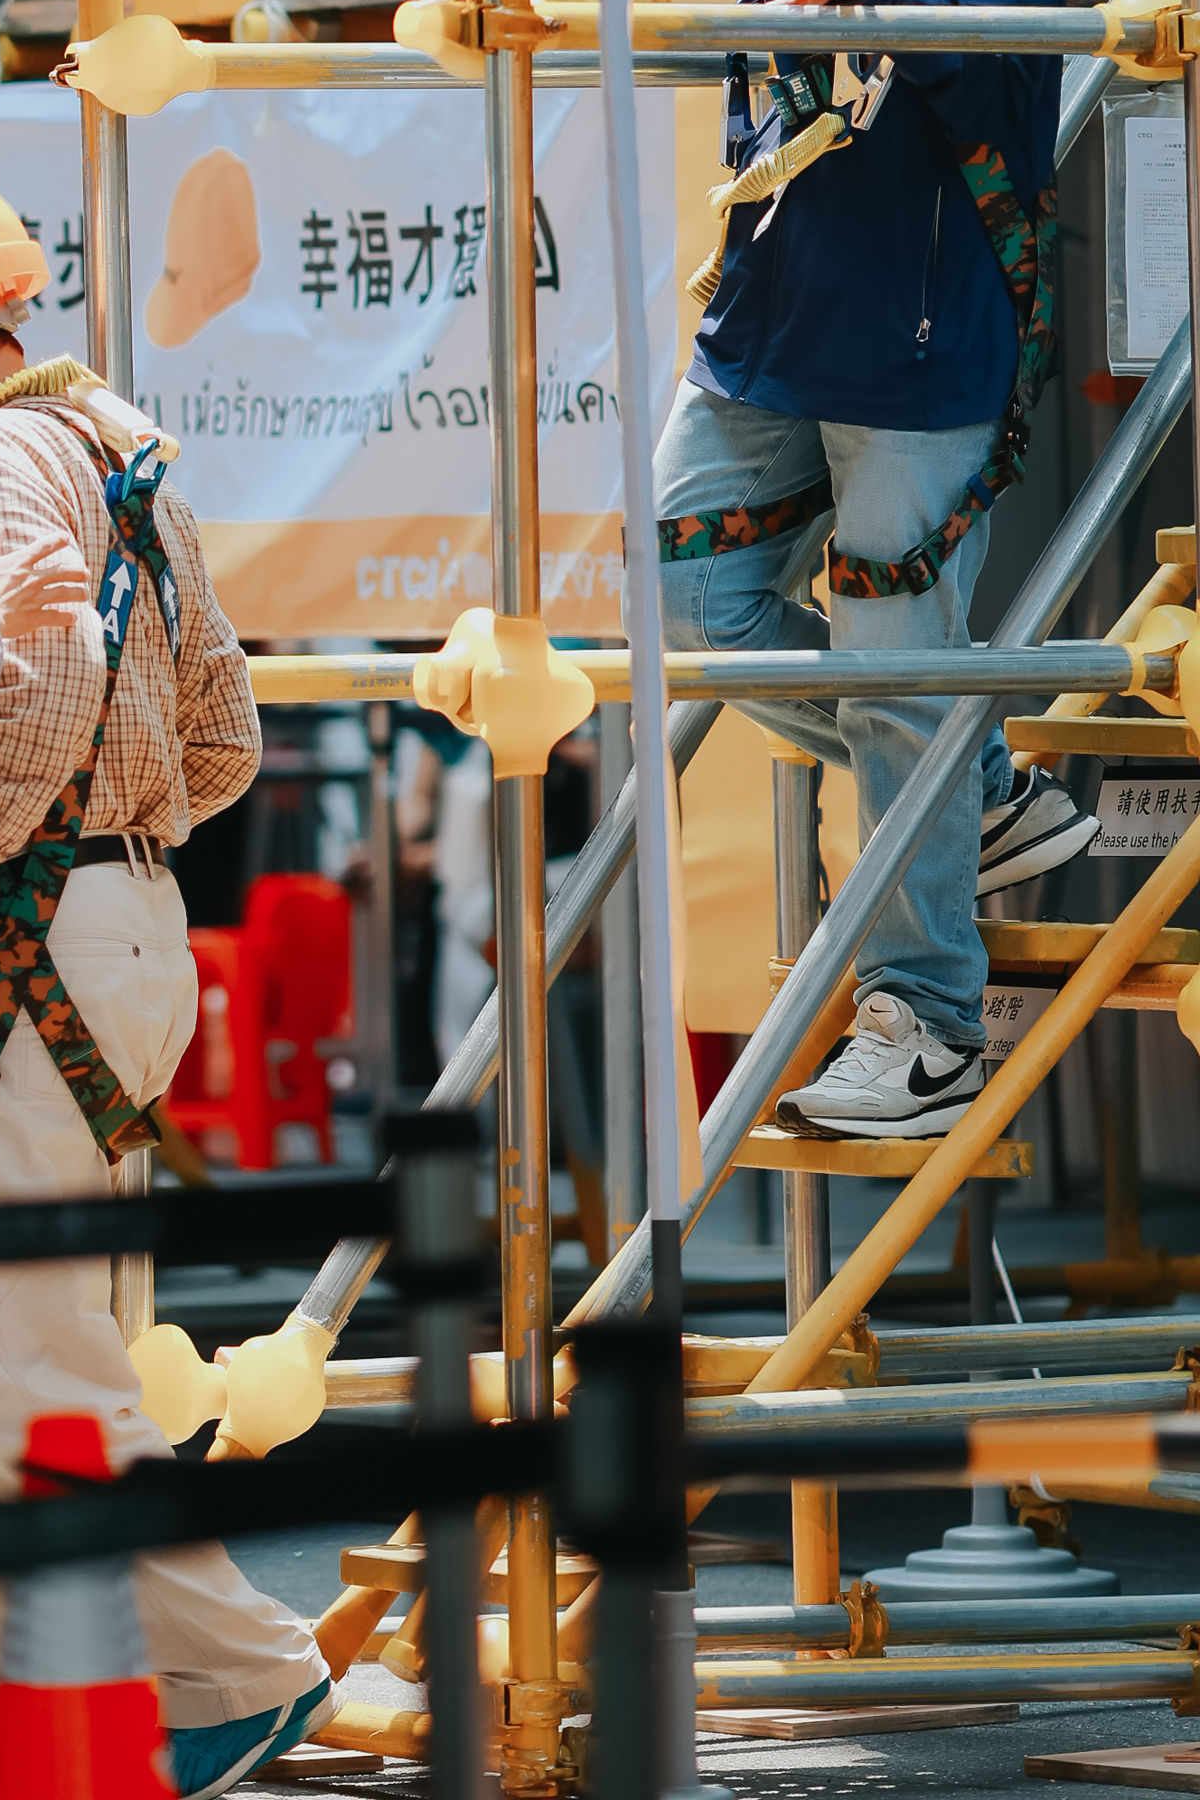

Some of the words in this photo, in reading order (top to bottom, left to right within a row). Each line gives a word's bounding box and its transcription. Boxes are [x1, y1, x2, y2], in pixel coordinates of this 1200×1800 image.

[300, 196, 559, 310] 幸福才穩
[357, 554, 440, 600] CTCI
[102, 608, 120, 643] A
[1094, 831, 1128, 848] Please
[1130, 835, 1149, 848] use
[1151, 831, 1169, 848] the
[984, 994, 1024, 1021] 踏階
[991, 1038, 1015, 1056] step
